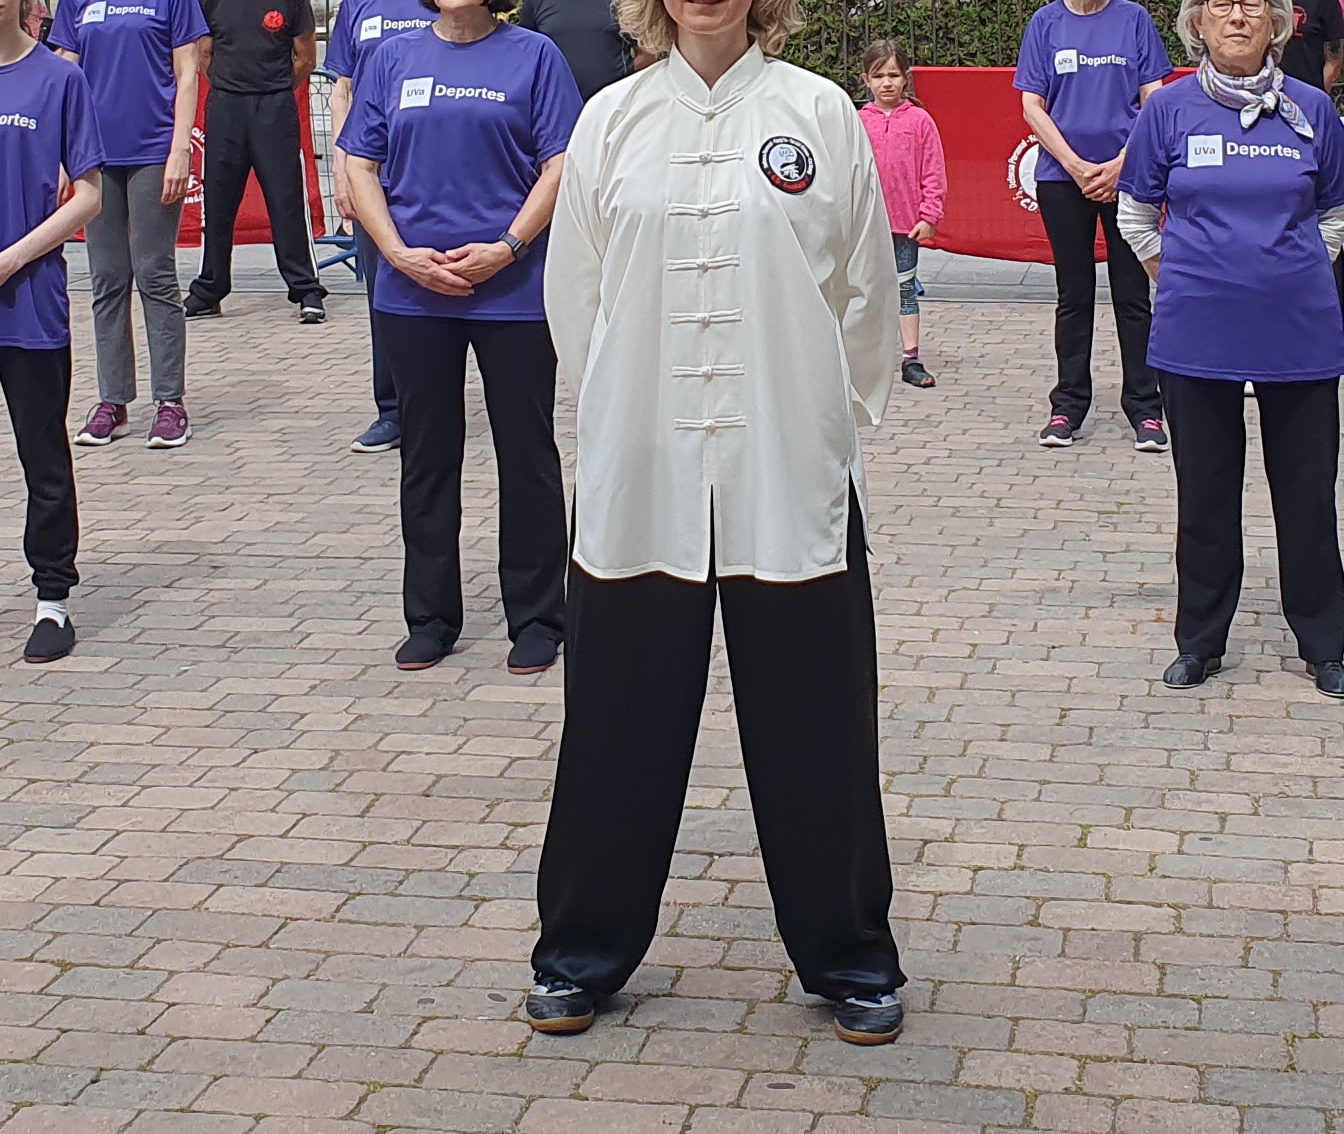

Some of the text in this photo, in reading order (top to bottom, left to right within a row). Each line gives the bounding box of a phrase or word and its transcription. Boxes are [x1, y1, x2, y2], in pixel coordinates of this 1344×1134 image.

[107, 5, 156, 17] Deportes
[1079, 54, 1127, 68] Deportes
[406, 84, 506, 102] UVa Deportes
[1194, 141, 1301, 160] UVa Deportes
